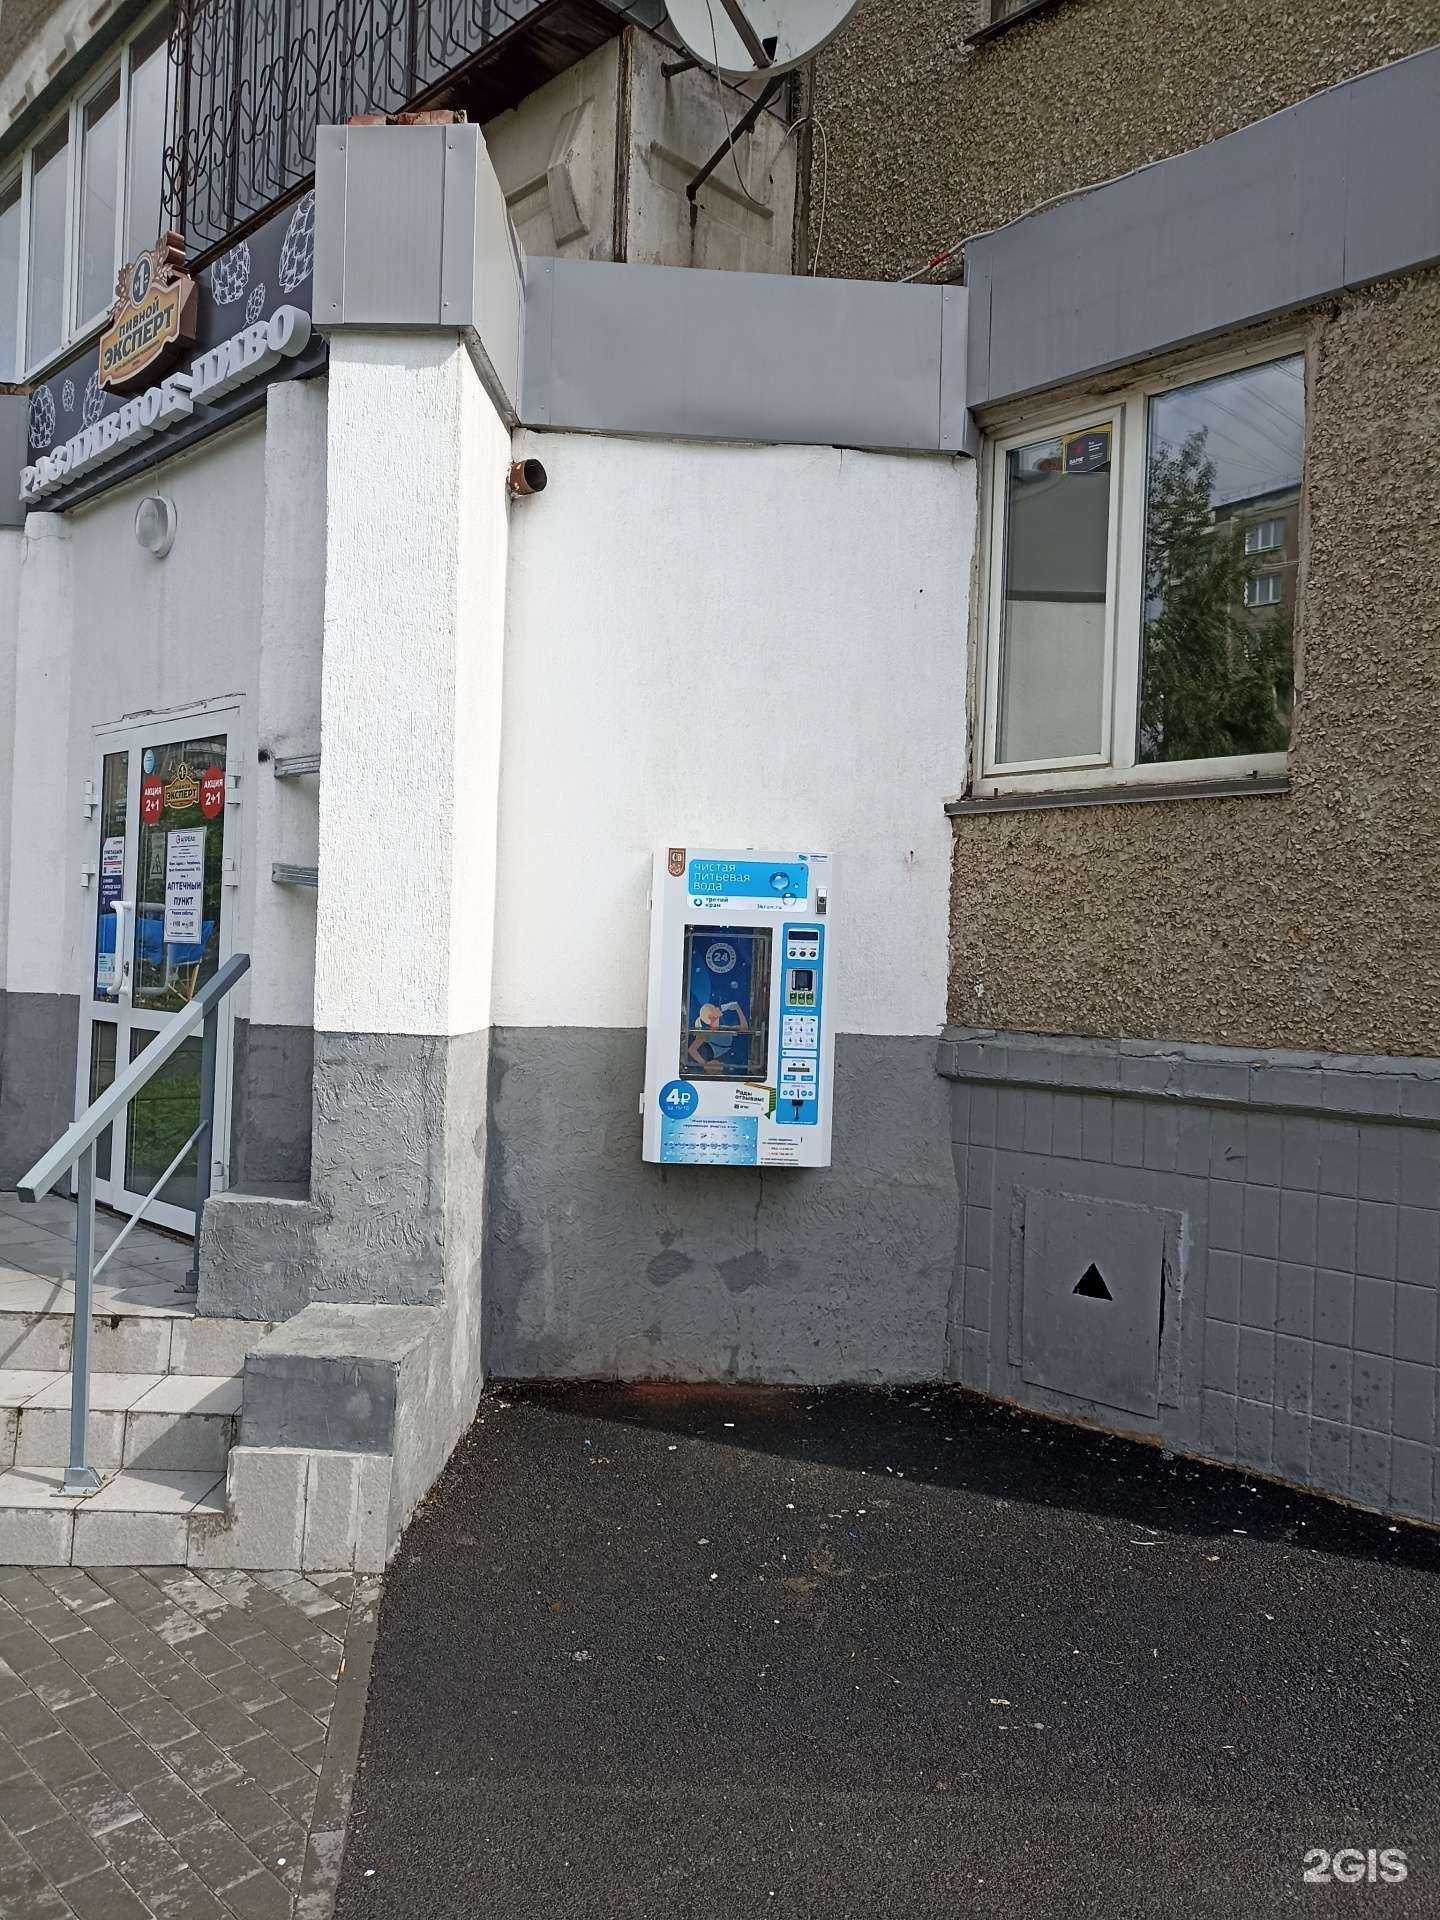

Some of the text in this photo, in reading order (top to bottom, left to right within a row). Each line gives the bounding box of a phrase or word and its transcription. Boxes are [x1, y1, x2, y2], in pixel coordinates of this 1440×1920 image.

[119, 296, 160, 337] ПИВНОЙ
[104, 304, 175, 370] ЭКСПЕРТ
[190, 304, 312, 405] ПИВО
[204, 779, 224, 789] АКЦИЯ
[144, 787, 162, 796] АКЦИЯ
[167, 789, 197, 800] ЭКСПЕРТ
[205, 791, 221, 806] 2+1
[145, 799, 160, 812] 2+1
[694, 863, 736, 872] чистая
[694, 872, 750, 882] питьевая
[693, 882, 722, 892] вода
[173, 896, 194, 906] ПУНКТ
[713, 952, 729, 962] 24
